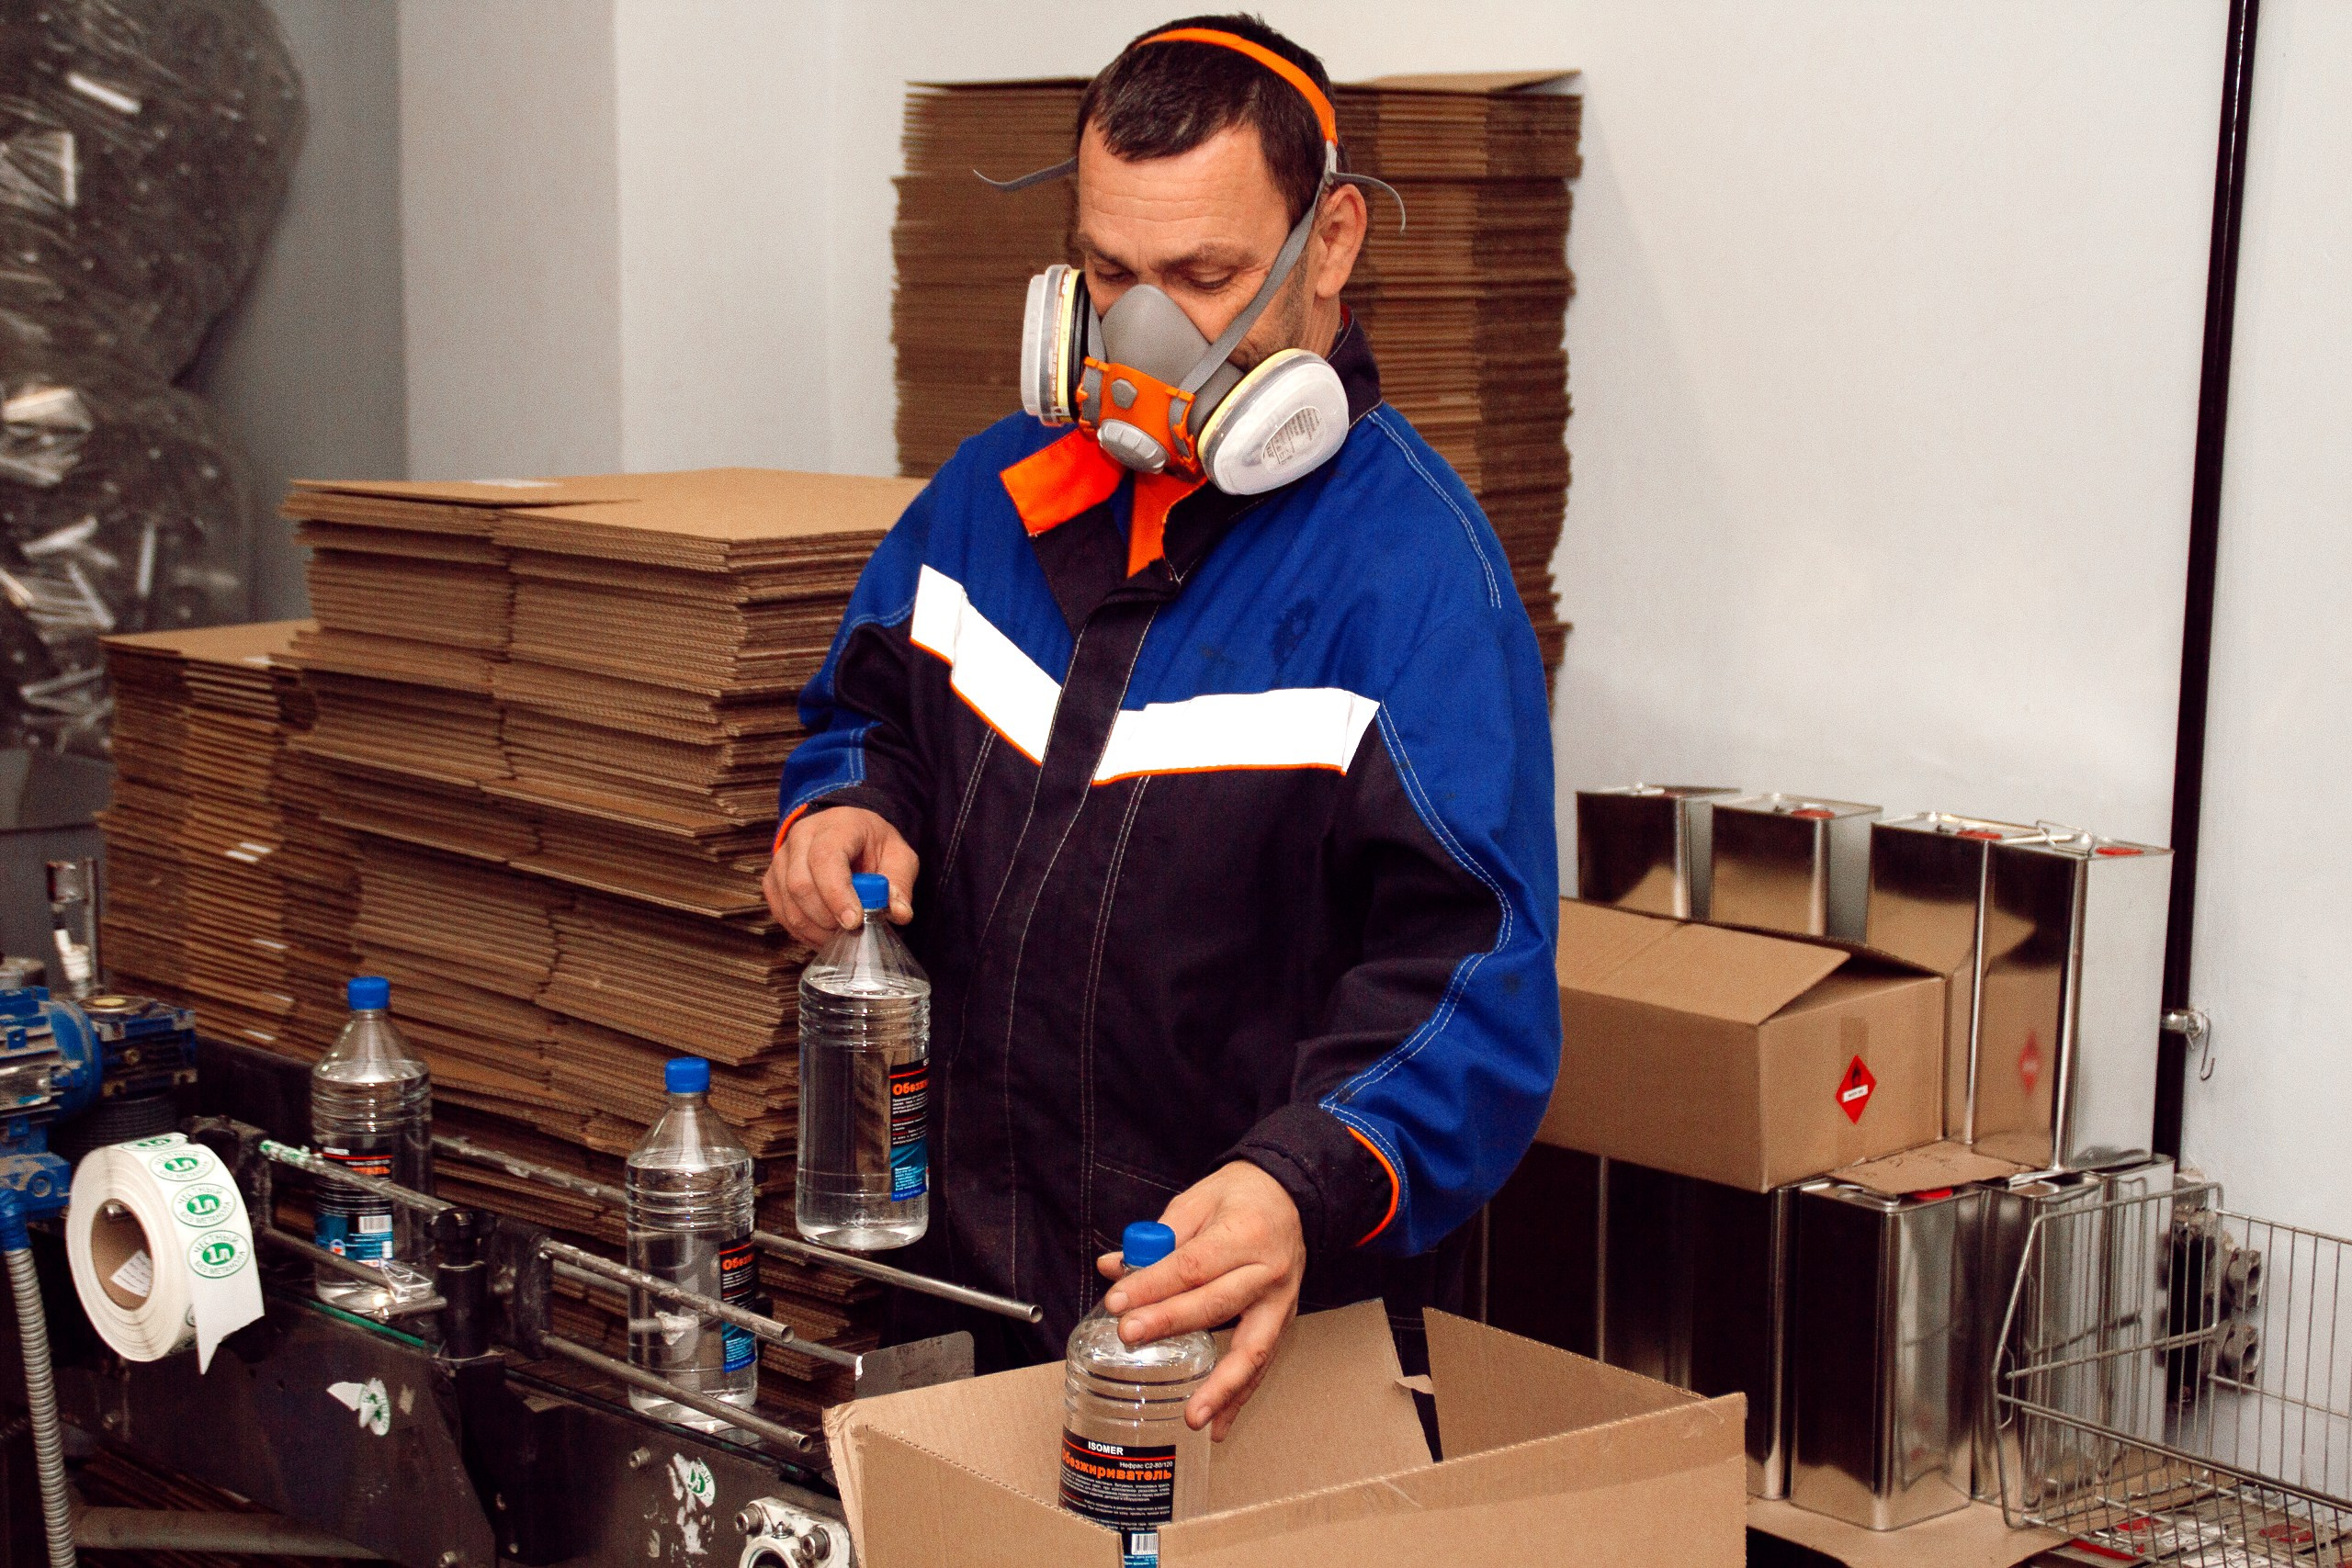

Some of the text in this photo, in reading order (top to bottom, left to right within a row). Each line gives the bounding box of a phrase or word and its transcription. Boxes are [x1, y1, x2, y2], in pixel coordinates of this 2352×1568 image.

[193, 1233, 240, 1253] ЧЕСТНЫЙ
[208, 1246, 232, 1263] 1л
[1088, 1441, 1124, 1455] ISOMER
[1062, 1447, 1172, 1481] Обезжириватель
[1120, 1461, 1144, 1470] Нефрас
